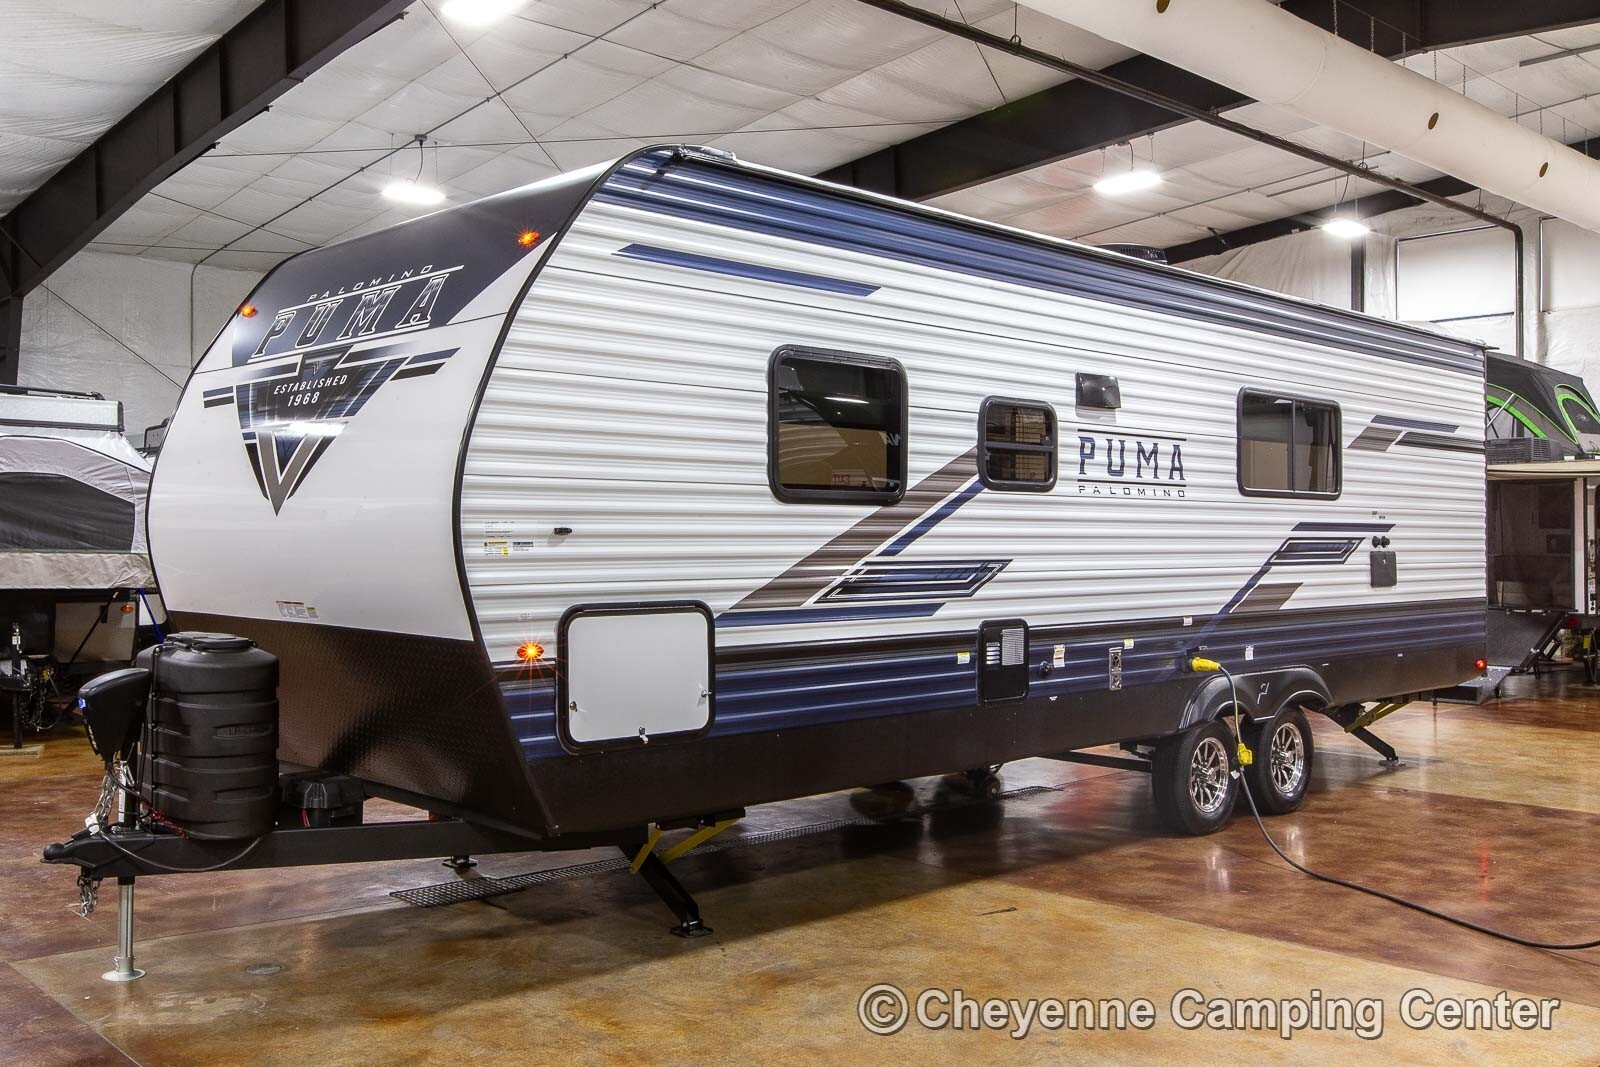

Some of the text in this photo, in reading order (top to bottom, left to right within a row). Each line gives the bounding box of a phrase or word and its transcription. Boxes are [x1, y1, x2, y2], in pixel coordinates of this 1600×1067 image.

[306, 264, 433, 302] PALOMINO
[251, 273, 450, 358] PUMA
[273, 374, 348, 395] ESTABLISHED
[287, 392, 320, 407] 1968
[1078, 436, 1186, 481] PUMA
[1078, 485, 1186, 497] PALOMINO
